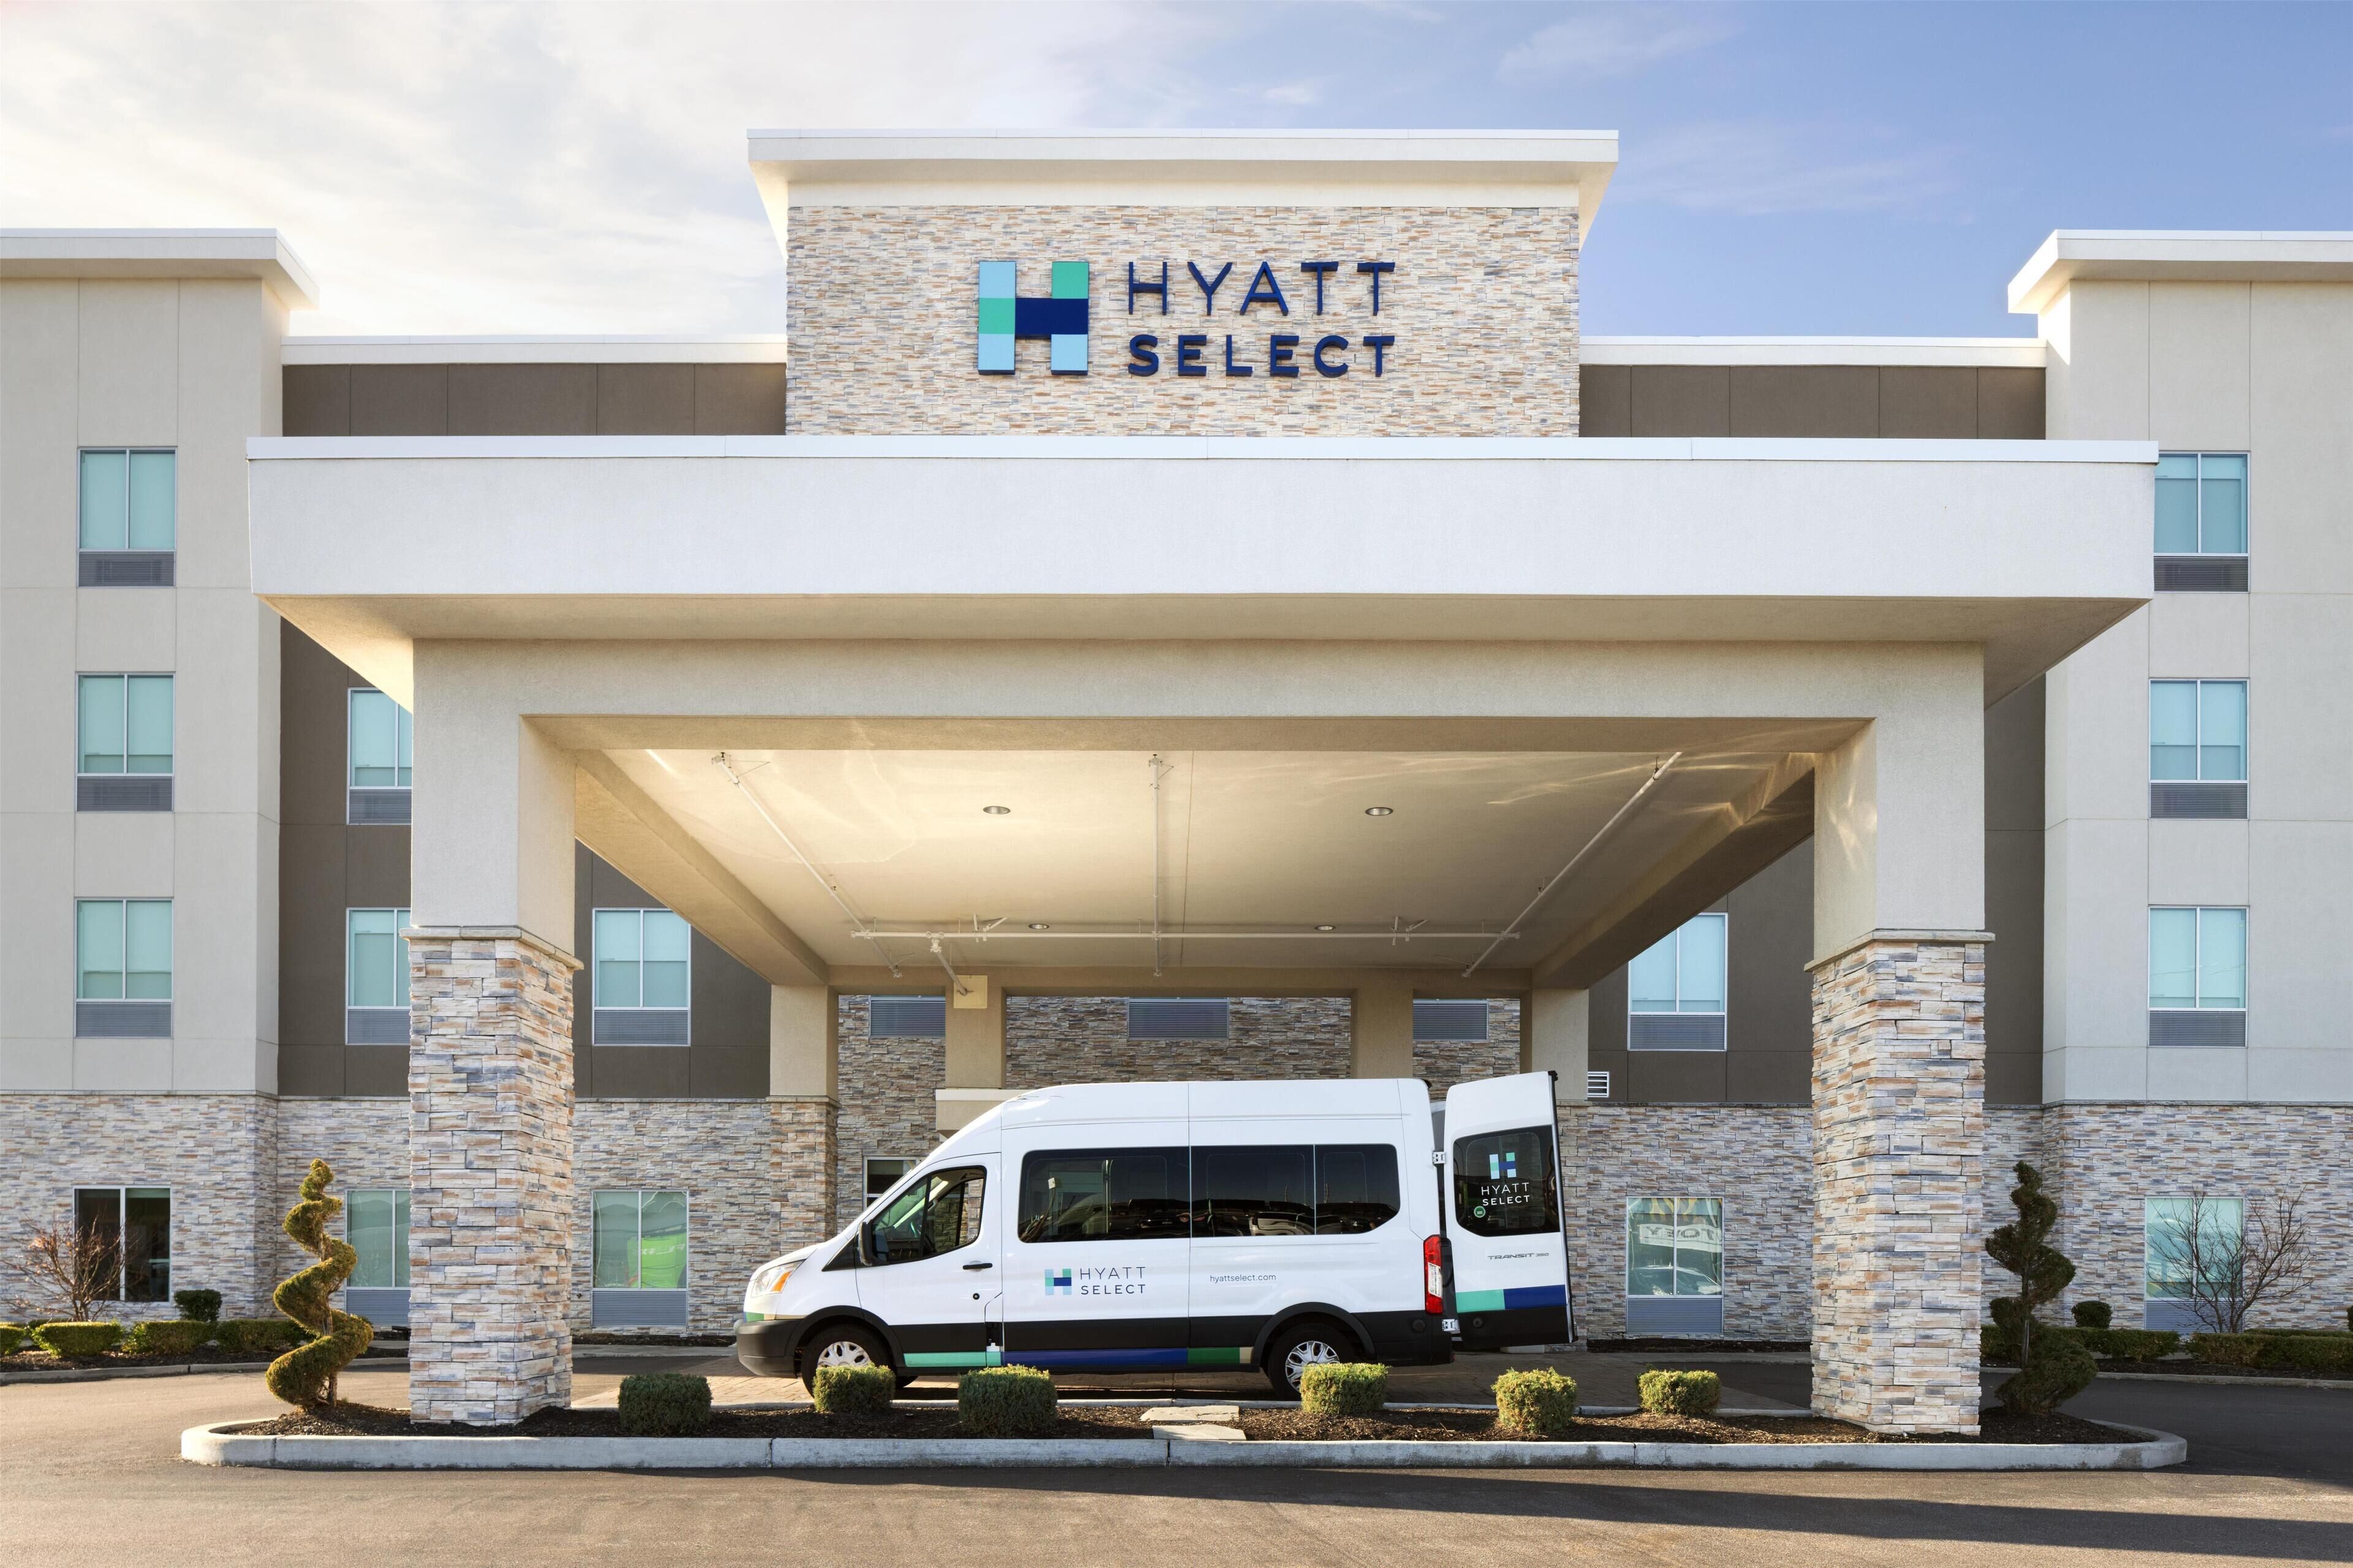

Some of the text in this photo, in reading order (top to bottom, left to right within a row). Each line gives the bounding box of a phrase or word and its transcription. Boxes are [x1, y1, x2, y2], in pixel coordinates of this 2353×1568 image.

[1128, 261, 1395, 316] HYATT
[1128, 335, 1395, 377] SELECT
[1481, 1182, 1529, 1195] HYATT
[1483, 1195, 1530, 1206] SELECT
[1080, 1267, 1146, 1280] HYATT
[1210, 1274, 1276, 1284] hyattselect.com
[1080, 1284, 1146, 1295] SELECT
